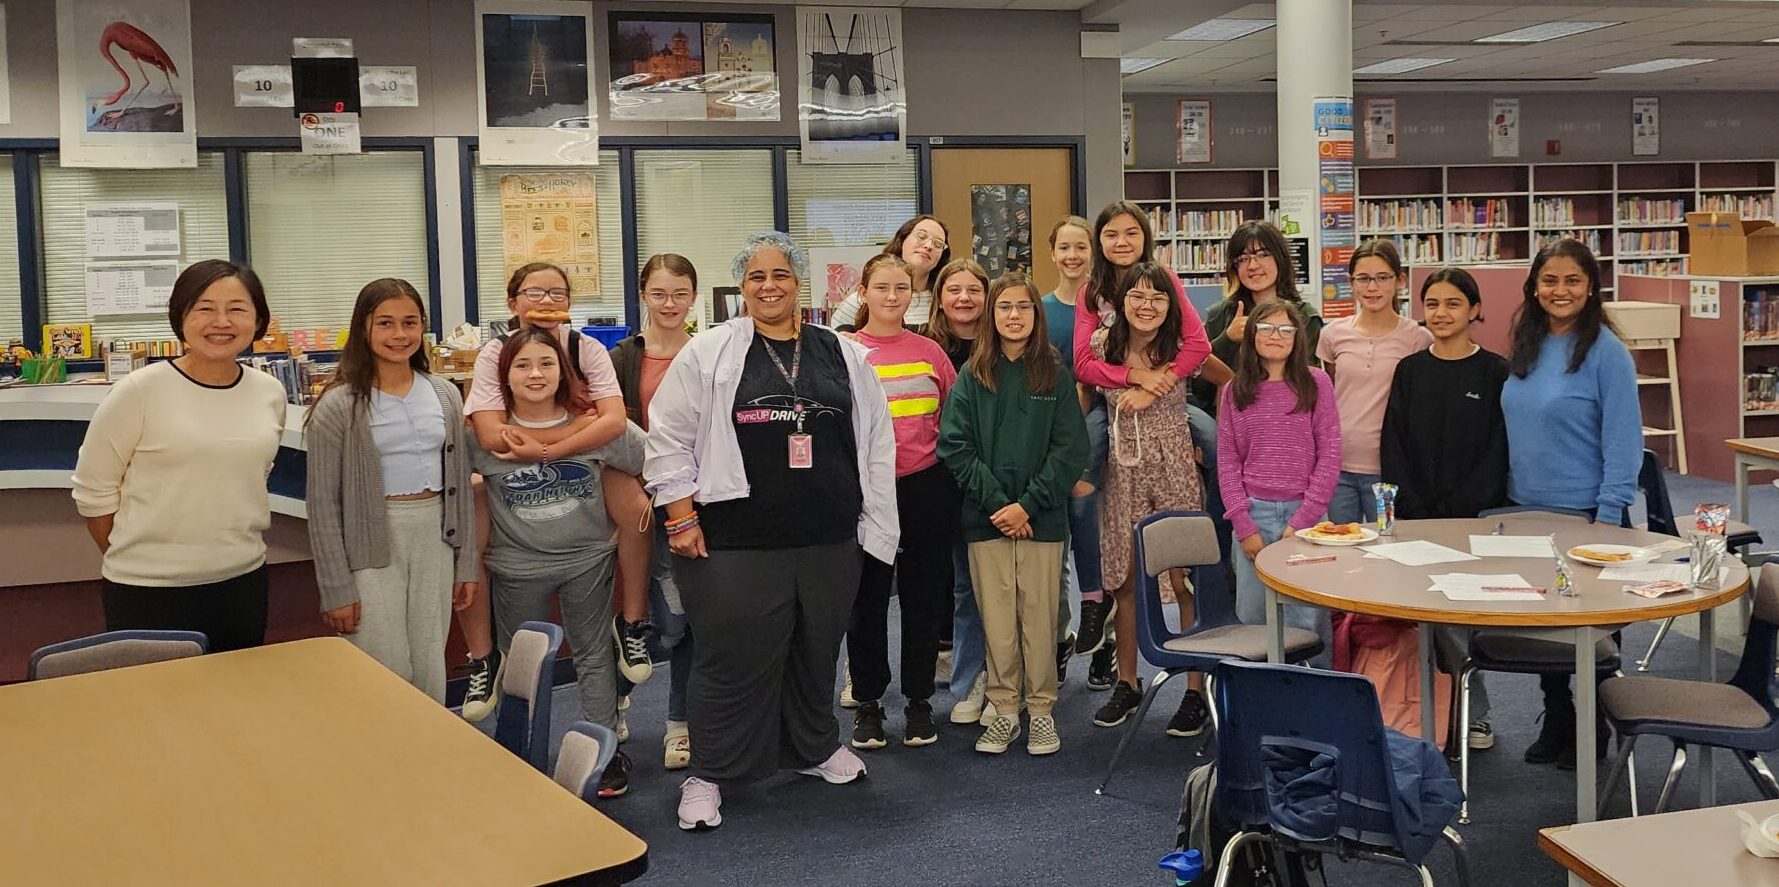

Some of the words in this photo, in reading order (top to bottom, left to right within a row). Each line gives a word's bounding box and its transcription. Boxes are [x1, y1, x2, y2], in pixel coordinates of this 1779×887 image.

[254, 80, 272, 91] 10
[380, 80, 397, 91] 10
[335, 101, 344, 112] 0
[314, 126, 346, 138] ONE
[737, 410, 769, 424] SyncUP
